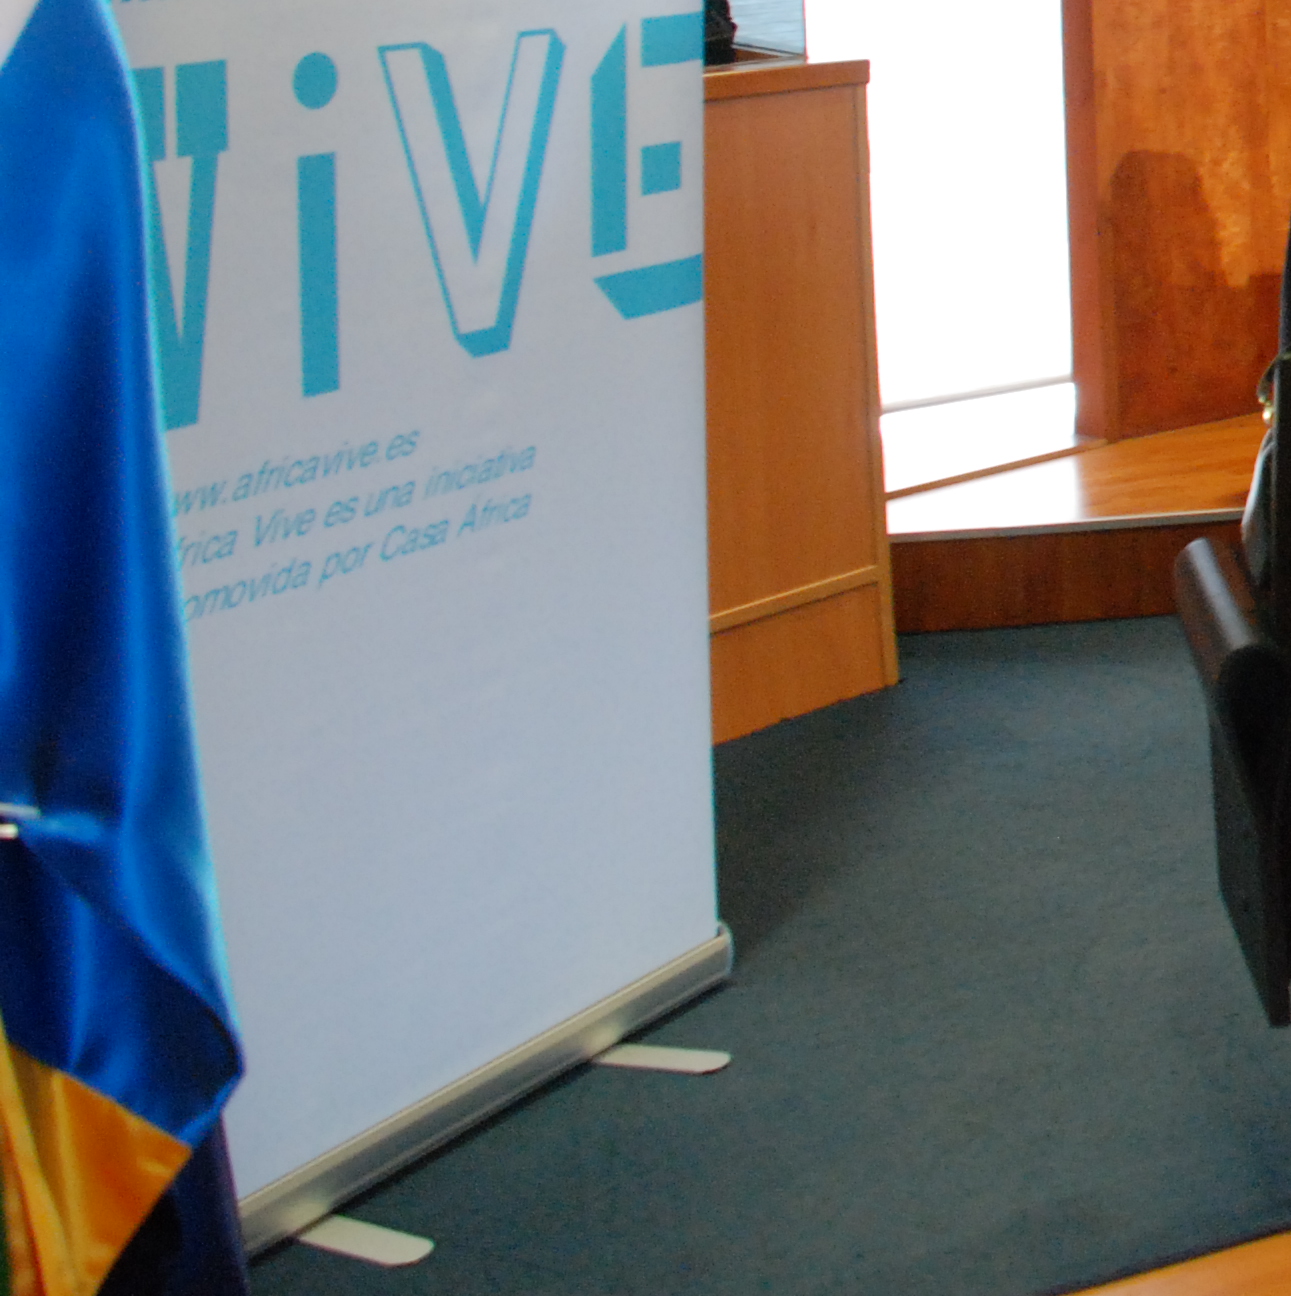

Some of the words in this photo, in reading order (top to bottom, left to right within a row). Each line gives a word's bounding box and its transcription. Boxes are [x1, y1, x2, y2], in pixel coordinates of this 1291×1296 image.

[254, 508, 316, 547] Vive
[323, 497, 359, 528] es
[364, 481, 416, 517] una
[424, 445, 536, 500] iniciativa
[318, 542, 374, 591] por
[380, 519, 449, 561] Casa
